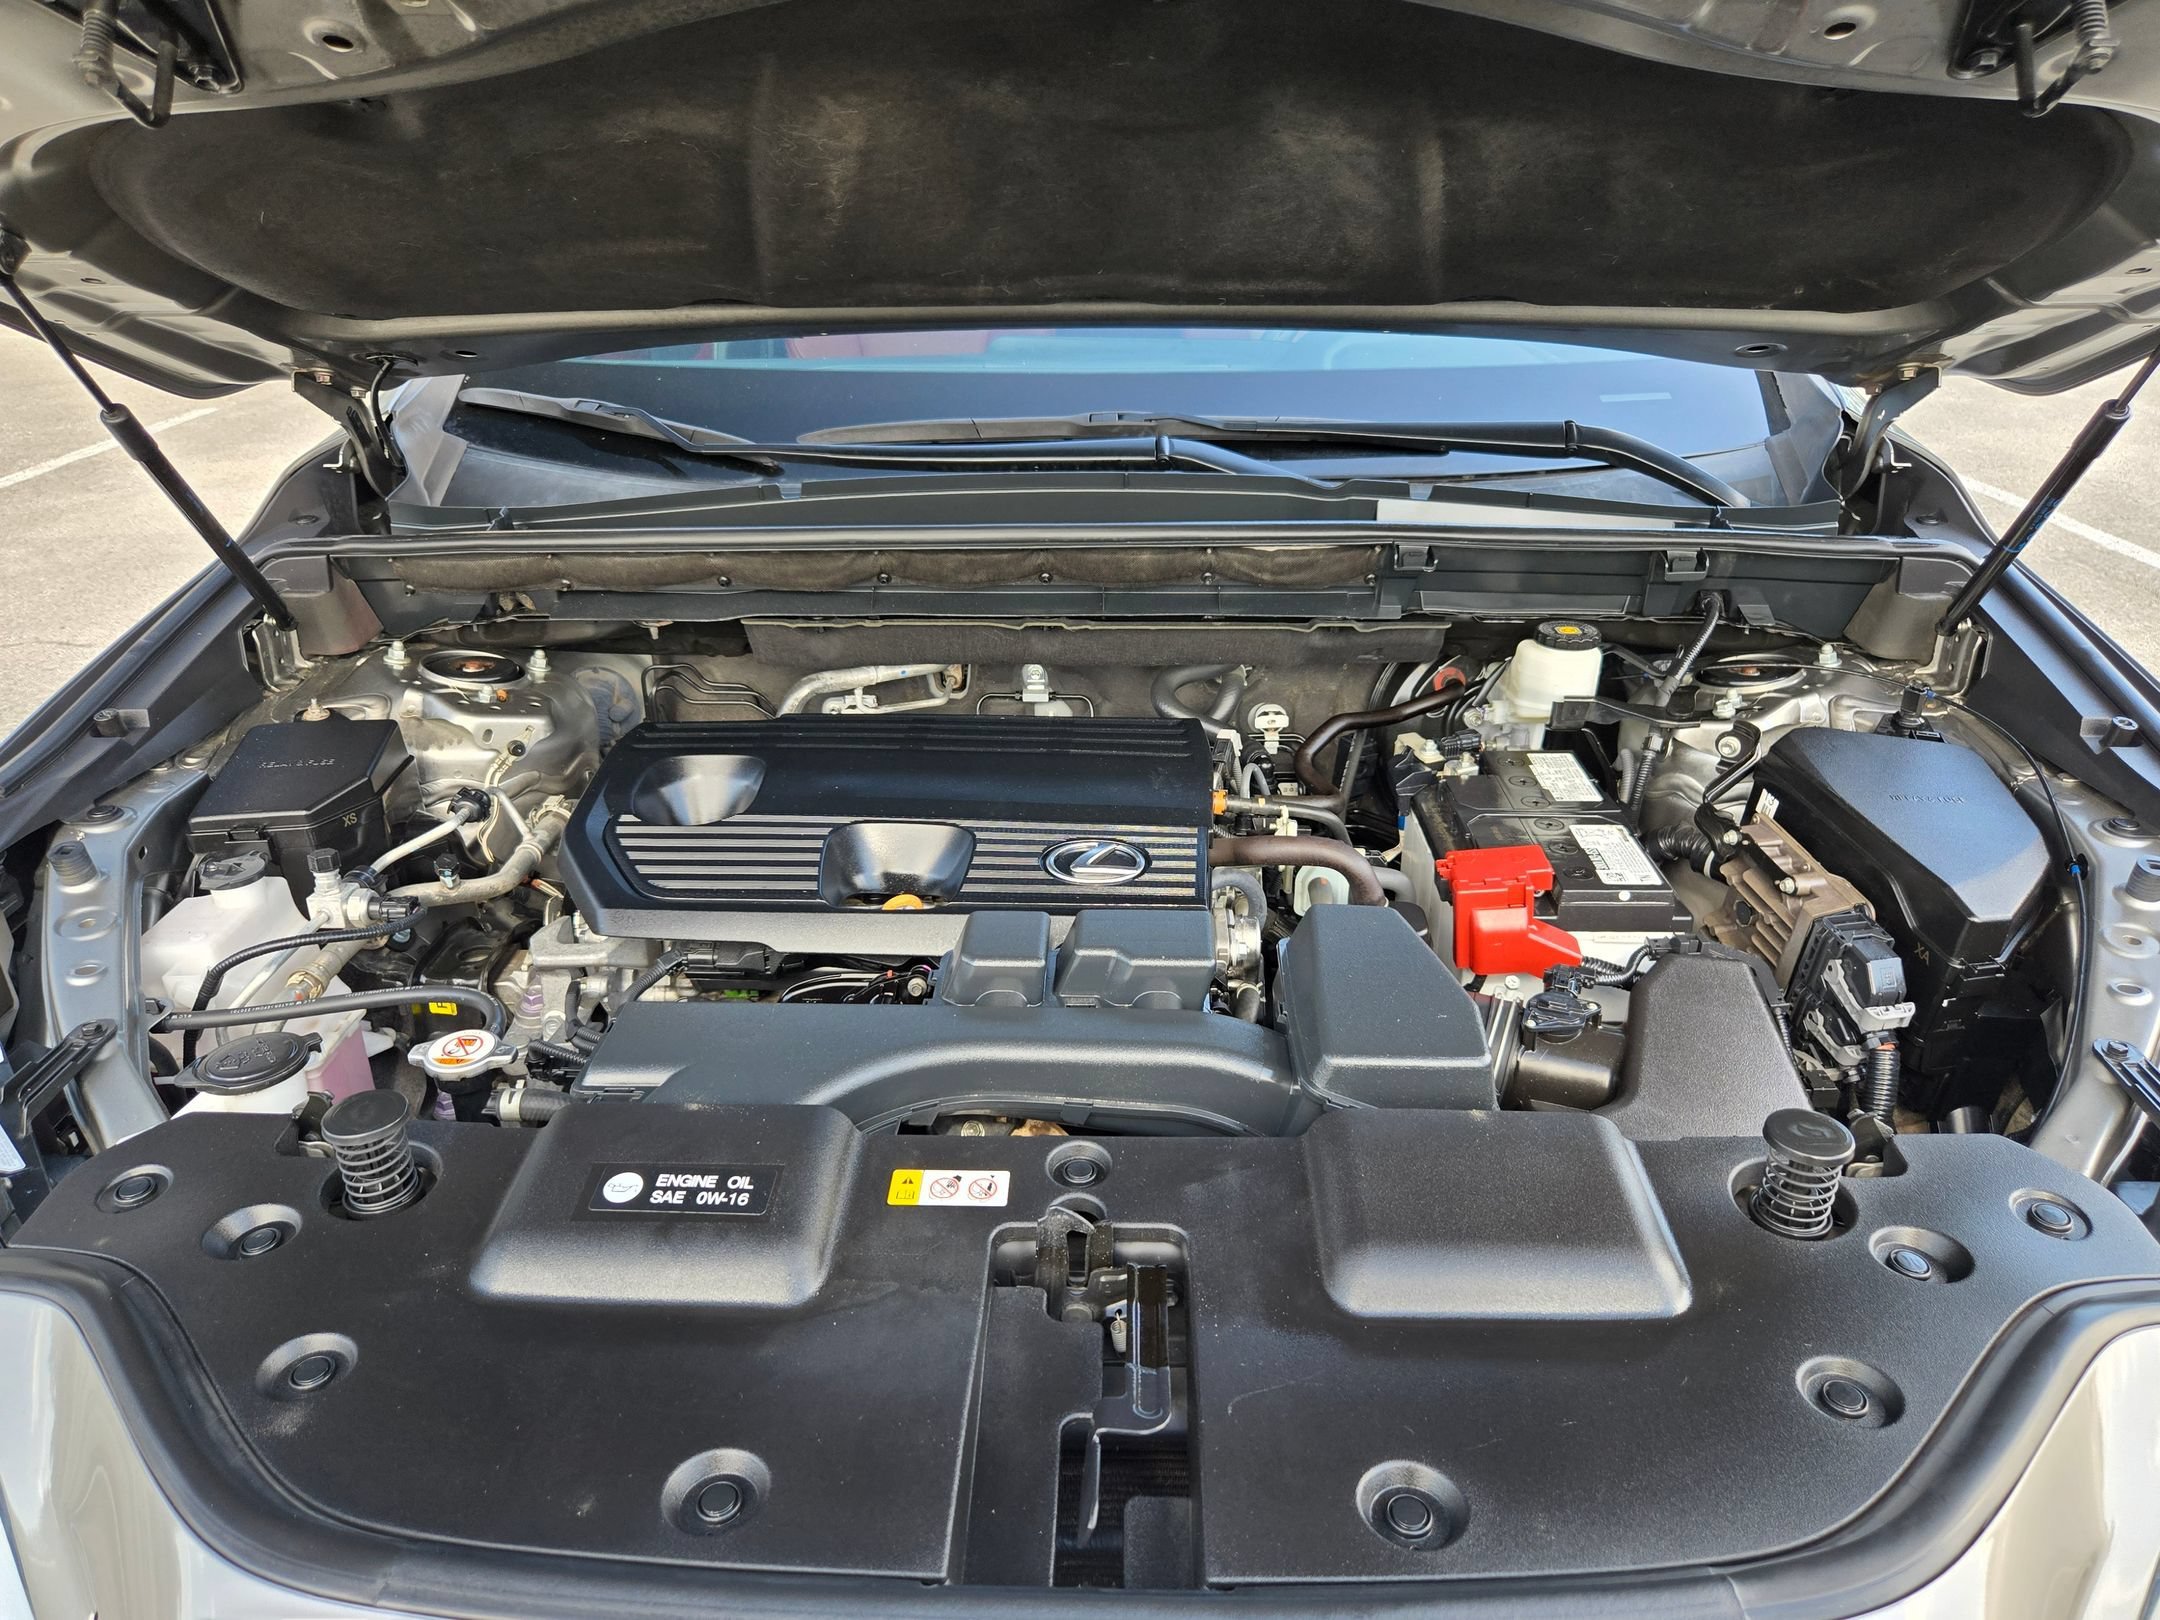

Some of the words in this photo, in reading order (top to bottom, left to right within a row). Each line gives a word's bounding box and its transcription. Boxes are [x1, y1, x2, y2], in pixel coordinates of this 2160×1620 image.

[342, 812, 358, 827] XS
[1913, 941, 1930, 967] XA
[655, 1173, 719, 1188] ENGINE
[727, 1175, 755, 1190] OIL
[649, 1190, 687, 1205] SAE
[695, 1191, 750, 1207] 0W-16
